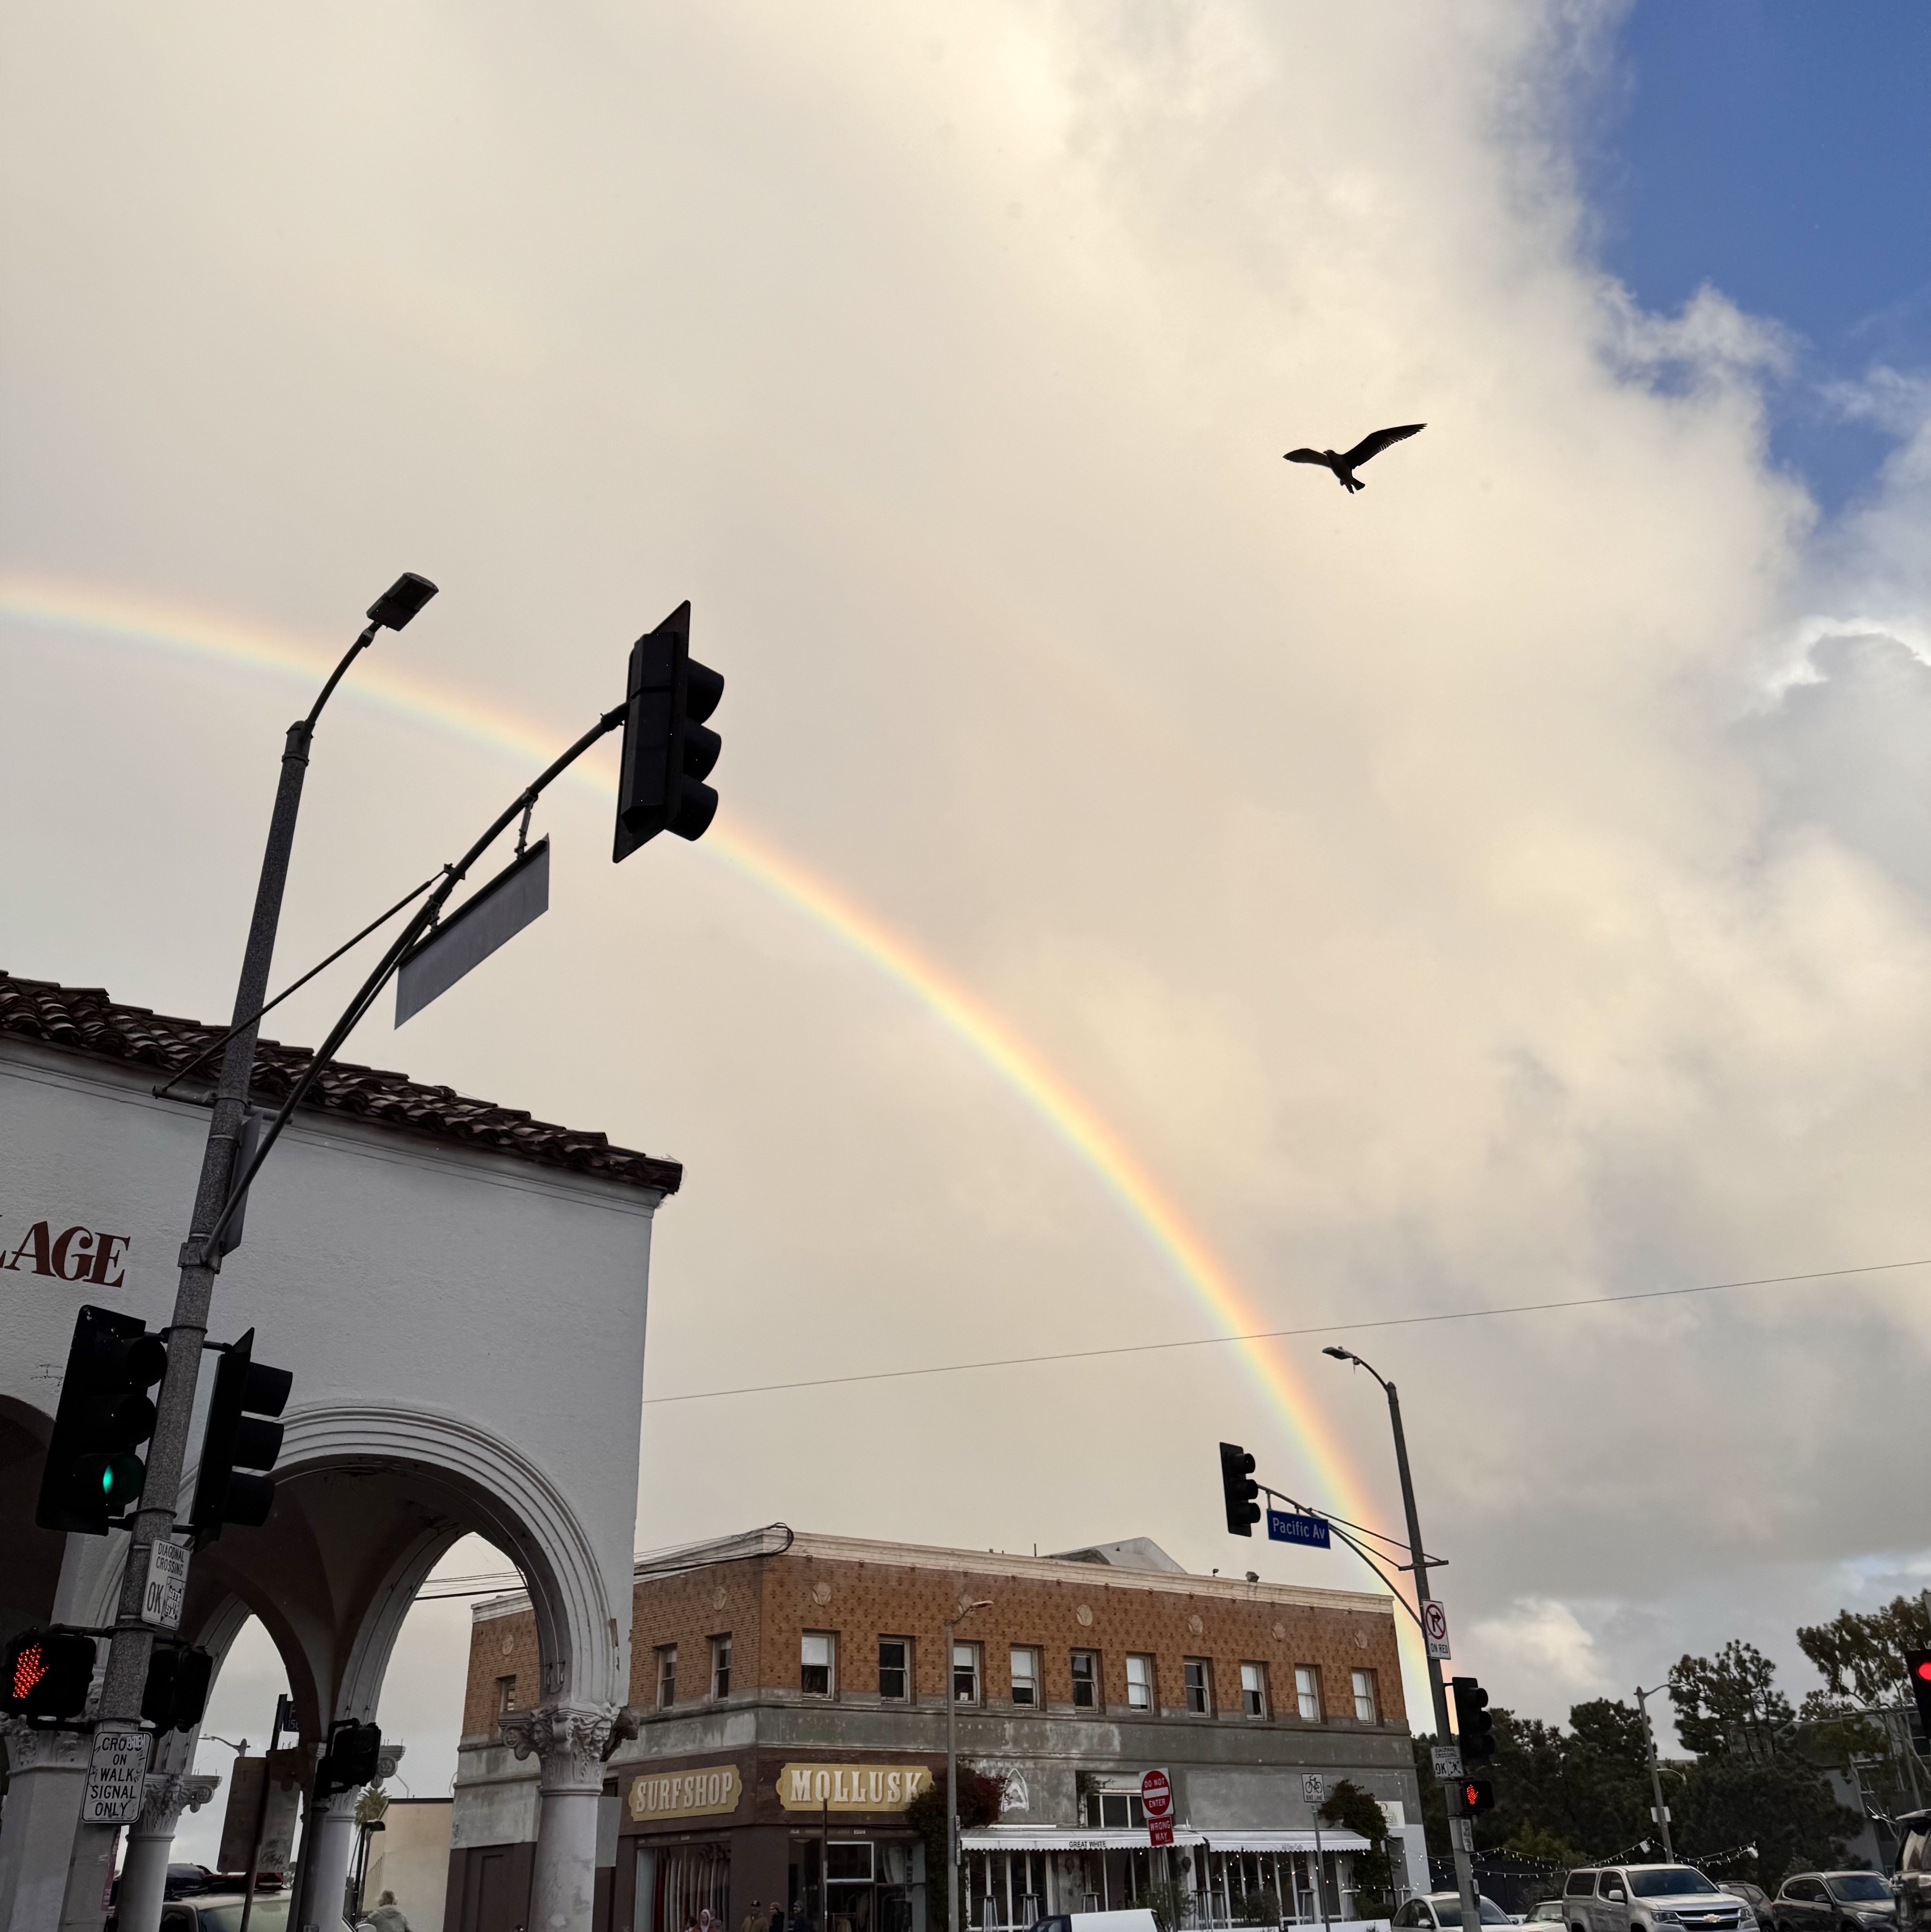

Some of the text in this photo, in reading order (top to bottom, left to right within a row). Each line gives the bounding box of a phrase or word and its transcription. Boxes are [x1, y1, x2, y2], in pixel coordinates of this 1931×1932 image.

[0, 1217, 130, 1287] AGE
[1272, 1517, 1325, 1540] Pacific Av
[158, 1543, 184, 1562] DIAGONAL
[156, 1556, 183, 1576] CROSSING
[147, 1581, 164, 1614] OK
[1431, 1643, 1448, 1653] ON RED
[113, 1754, 127, 1765] ON
[101, 1768, 134, 1781] WALK
[1436, 1763, 1446, 1775] OK
[790, 1770, 922, 1803] MOLLUSK
[1144, 1778, 1165, 1788] DO NOT
[91, 1785, 136, 1799] SIGNAL
[95, 1803, 128, 1817] ONLY
[1149, 1799, 1166, 1808] ENTER
[1150, 1820, 1171, 1831] WRONG
[1155, 1831, 1168, 1841] WAY
